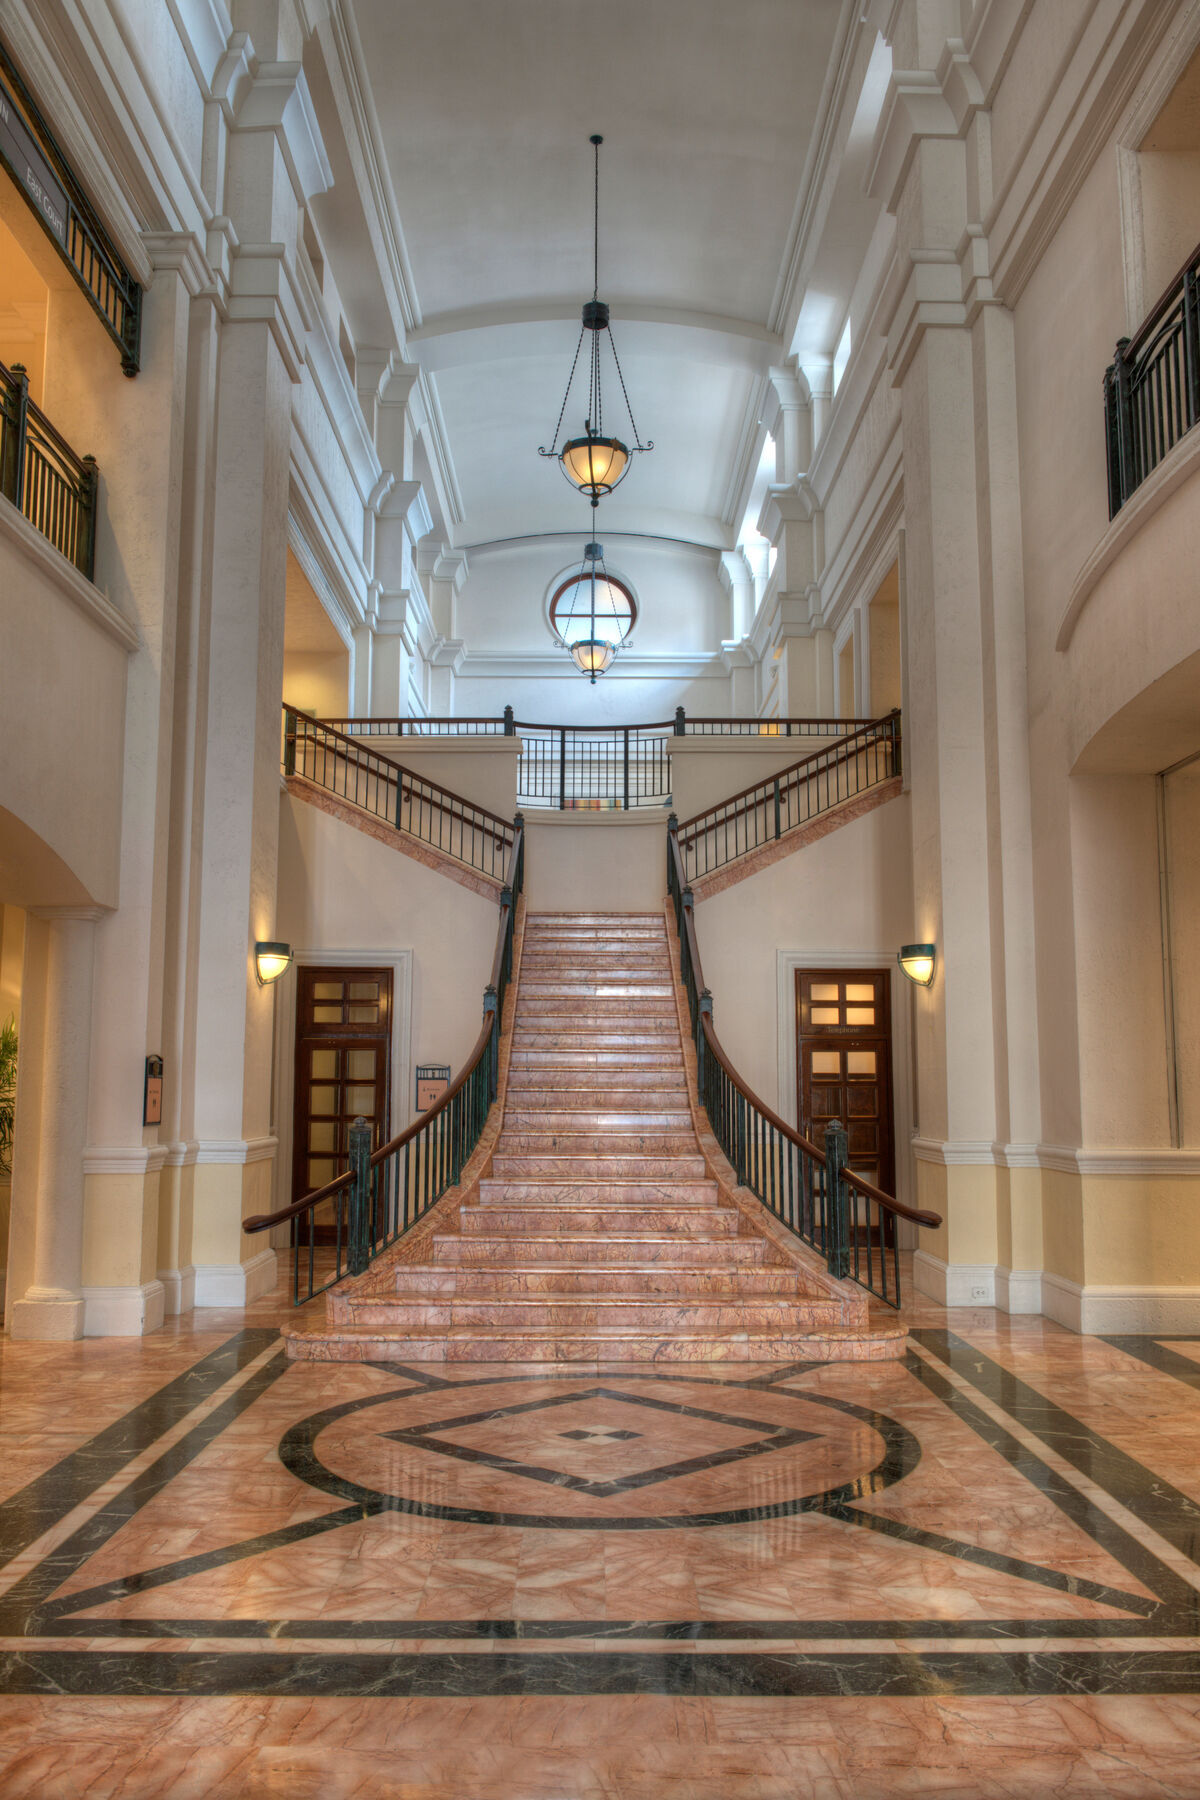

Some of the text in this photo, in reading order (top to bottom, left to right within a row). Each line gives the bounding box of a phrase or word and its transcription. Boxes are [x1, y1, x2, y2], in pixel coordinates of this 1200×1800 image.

[27, 167, 63, 236] East Court
[826, 1026, 860, 1034] Telephone
